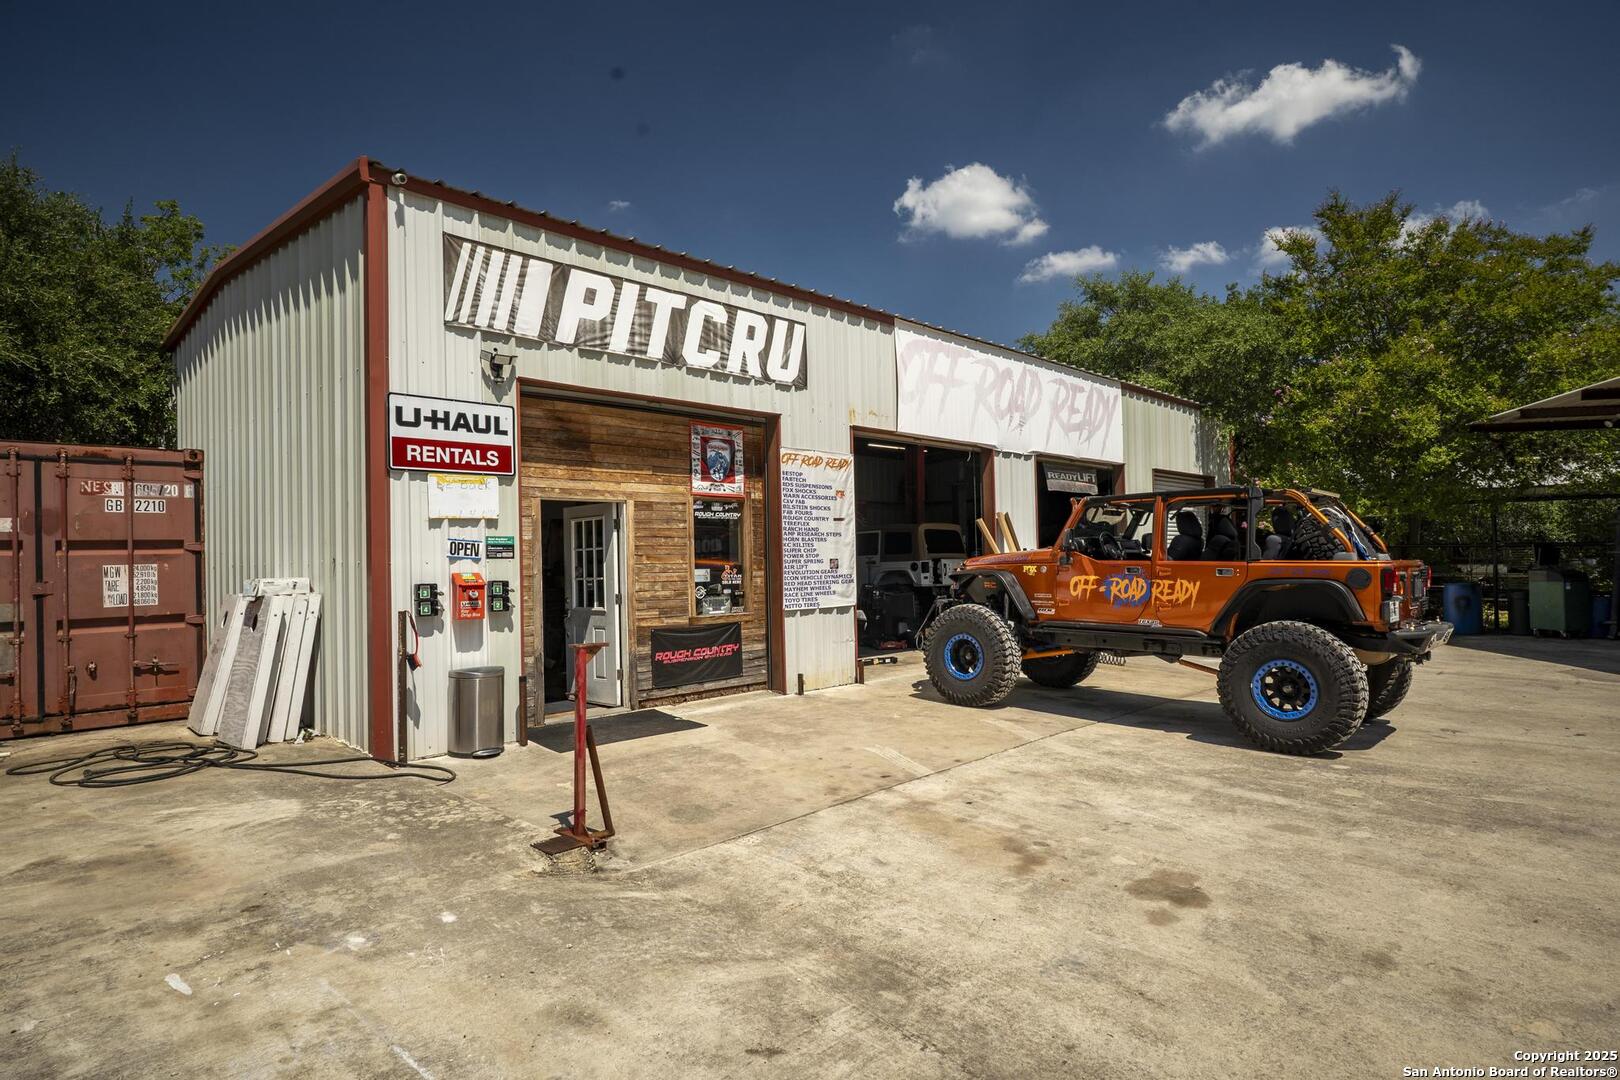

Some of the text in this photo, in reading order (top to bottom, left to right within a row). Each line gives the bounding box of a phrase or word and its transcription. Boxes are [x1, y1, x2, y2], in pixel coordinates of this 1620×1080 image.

[555, 268, 806, 383] PITCRU
[970, 358, 1043, 437] ROAD
[1047, 377, 1119, 455] READY
[395, 405, 508, 436] U-HAUL
[406, 444, 500, 467] RENTALS
[781, 452, 852, 471] OFF ROAD READY
[106, 499, 165, 513] GB 2210
[450, 541, 480, 557] OPEN
[1070, 575, 1101, 601] OFF
[1109, 576, 1147, 605] ROAD
[1151, 577, 1200, 611] READY
[655, 643, 740, 661] ROUGH COUNTRY
